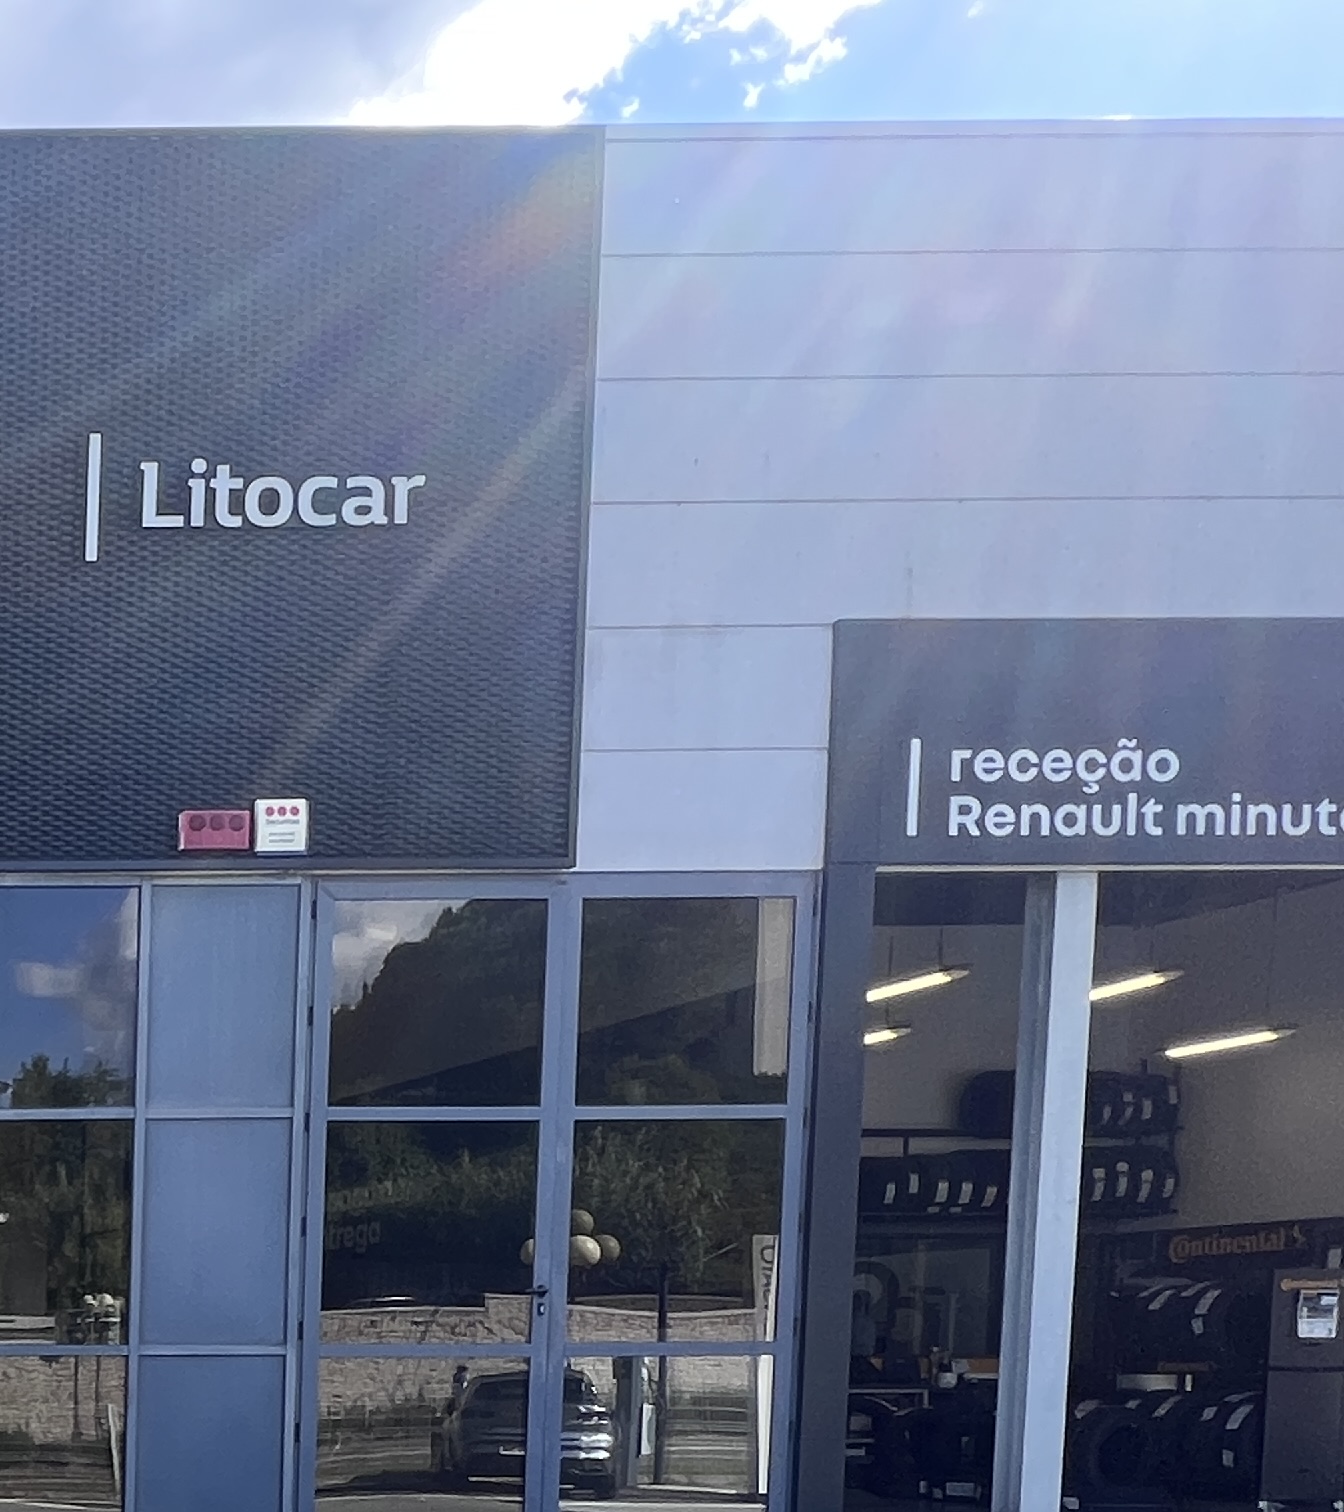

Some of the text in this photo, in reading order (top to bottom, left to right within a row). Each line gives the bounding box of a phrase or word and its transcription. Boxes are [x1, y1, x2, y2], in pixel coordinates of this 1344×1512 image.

[139, 458, 427, 528] Litocar
[949, 737, 1180, 794] receção
[948, 793, 1344, 837] Renault minut
[1169, 1227, 1285, 1264] Continental
